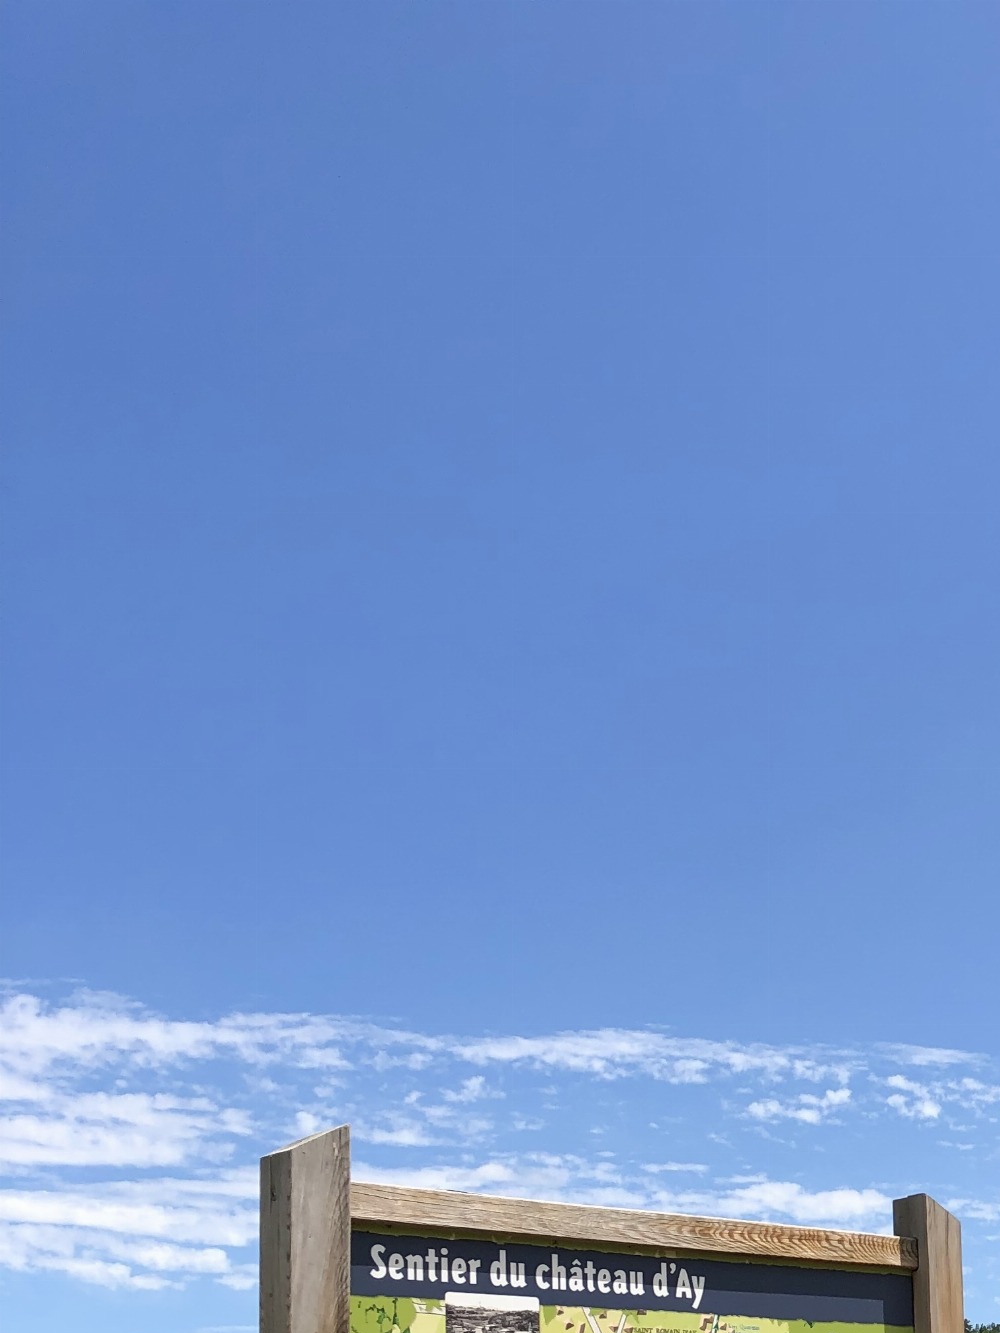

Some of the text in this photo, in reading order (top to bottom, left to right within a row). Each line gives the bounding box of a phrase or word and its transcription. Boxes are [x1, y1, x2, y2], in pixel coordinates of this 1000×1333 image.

[369, 1244, 705, 1309] Sentier du château d'Ay
